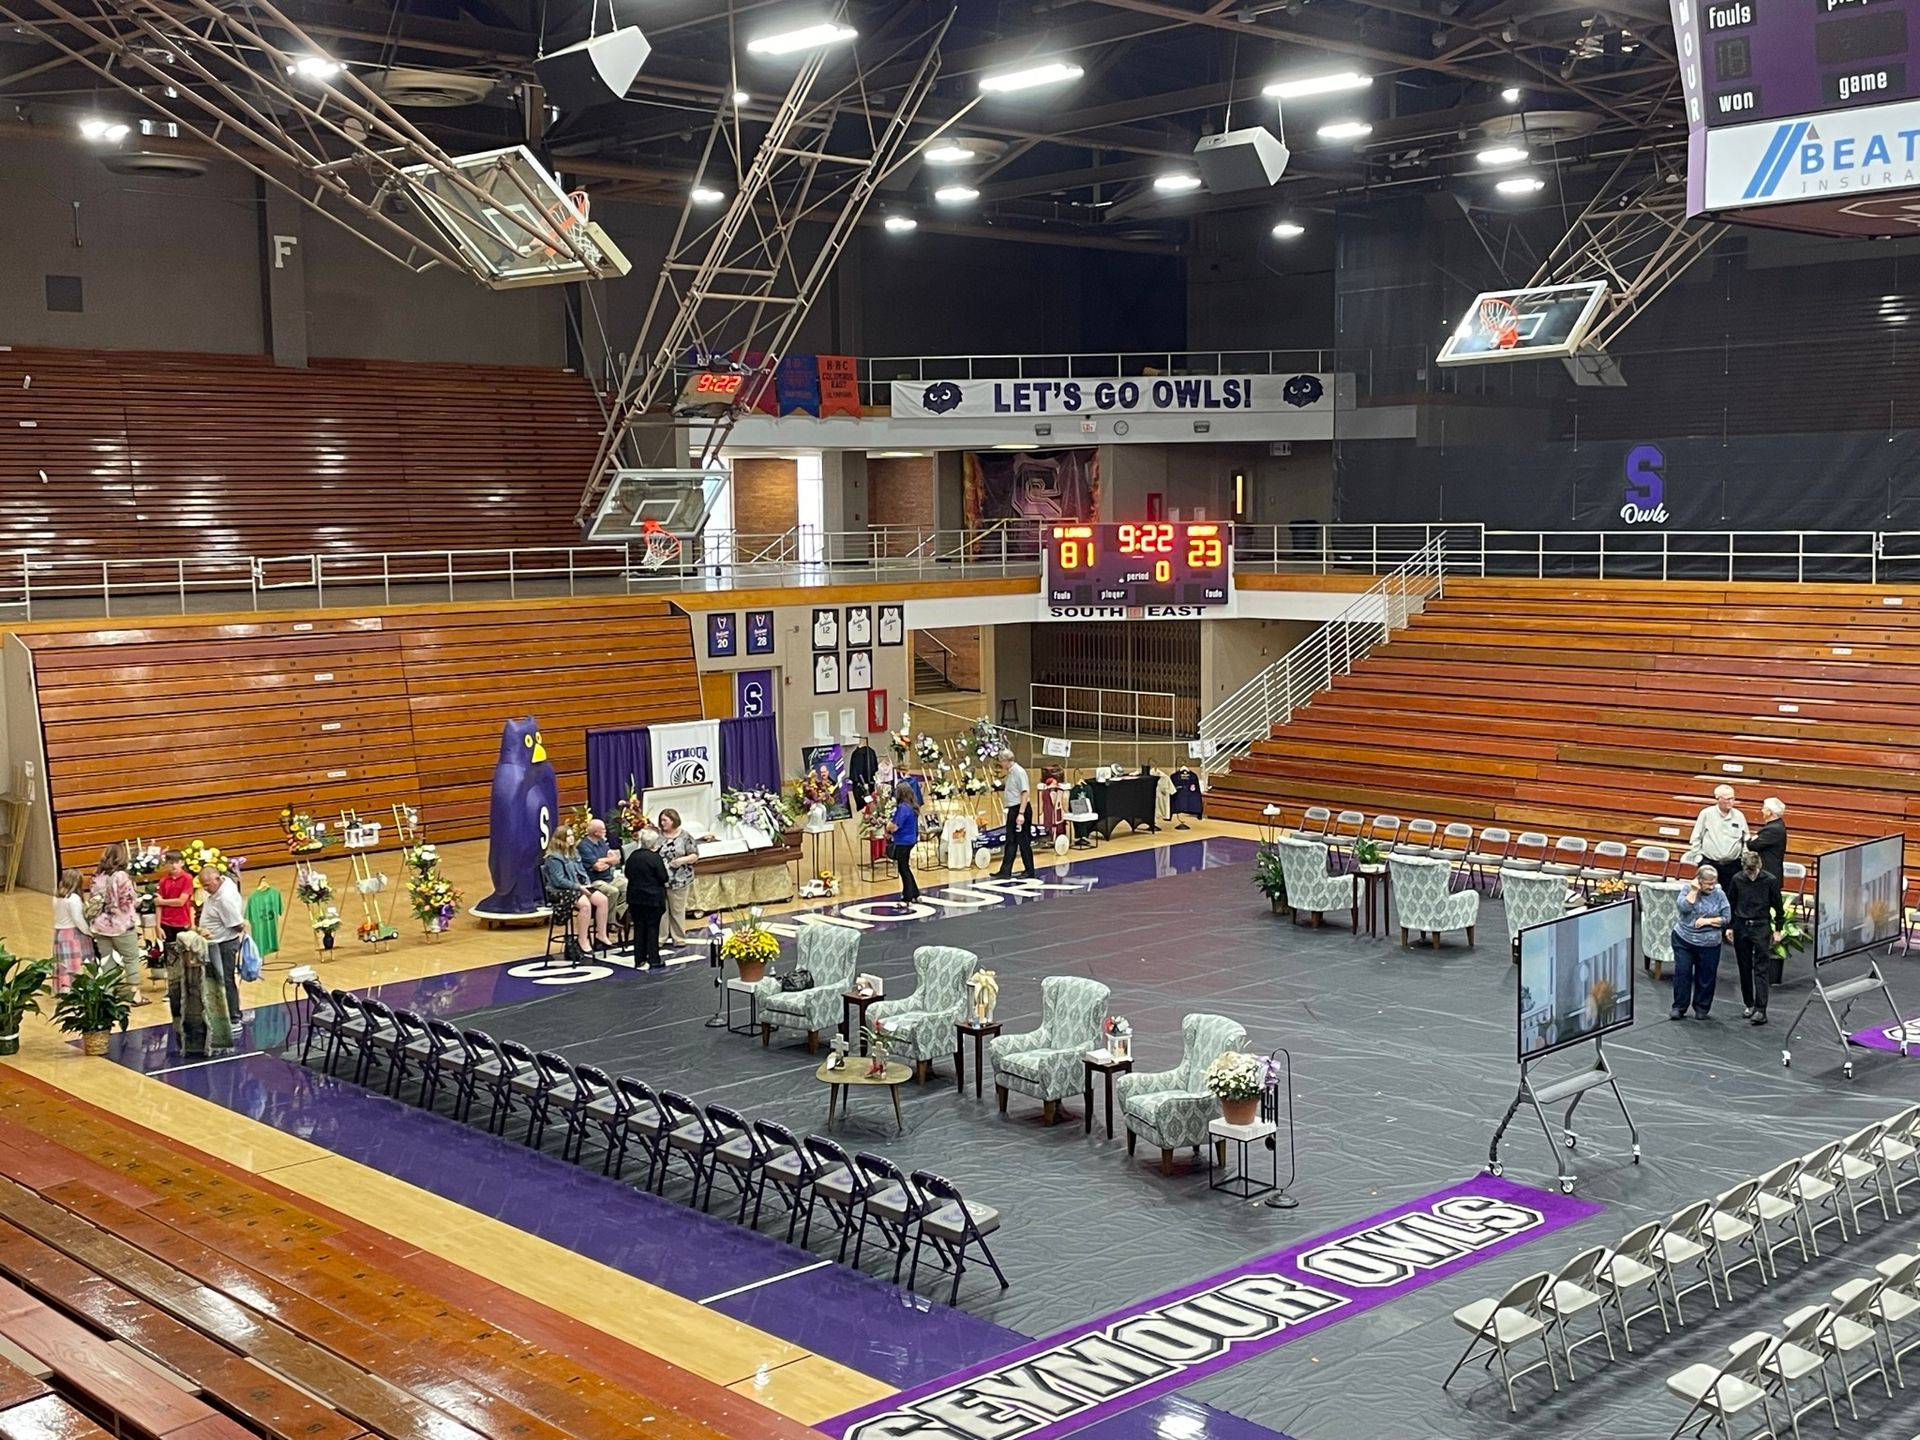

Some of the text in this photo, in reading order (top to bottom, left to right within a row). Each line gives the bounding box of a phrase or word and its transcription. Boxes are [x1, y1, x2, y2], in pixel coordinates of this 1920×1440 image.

[1709, 4, 1752, 29] fouls
[1839, 71, 1888, 99] game
[1719, 91, 1754, 112] won
[273, 235, 297, 268] F
[696, 374, 743, 393] 9:22
[994, 379, 1252, 412] LET'S GO OWLS!
[1626, 444, 1665, 509] S
[1620, 502, 1669, 524] Owls
[1118, 524, 1174, 553] 9:22
[1060, 541, 1095, 569] 81
[1187, 539, 1223, 568] 23
[1126, 572, 1149, 582] period
[1154, 560, 1171, 583] 0
[1101, 590, 1126, 600] player
[1050, 607, 1125, 618] SOUTH
[1147, 606, 1207, 617] EAST
[717, 639, 729, 649] 20
[757, 636, 768, 647] 28
[744, 682, 763, 717] S
[667, 746, 709, 766] SEYMOUR
[539, 806, 550, 850] S
[1296, 1194, 1545, 1290] OWLS
